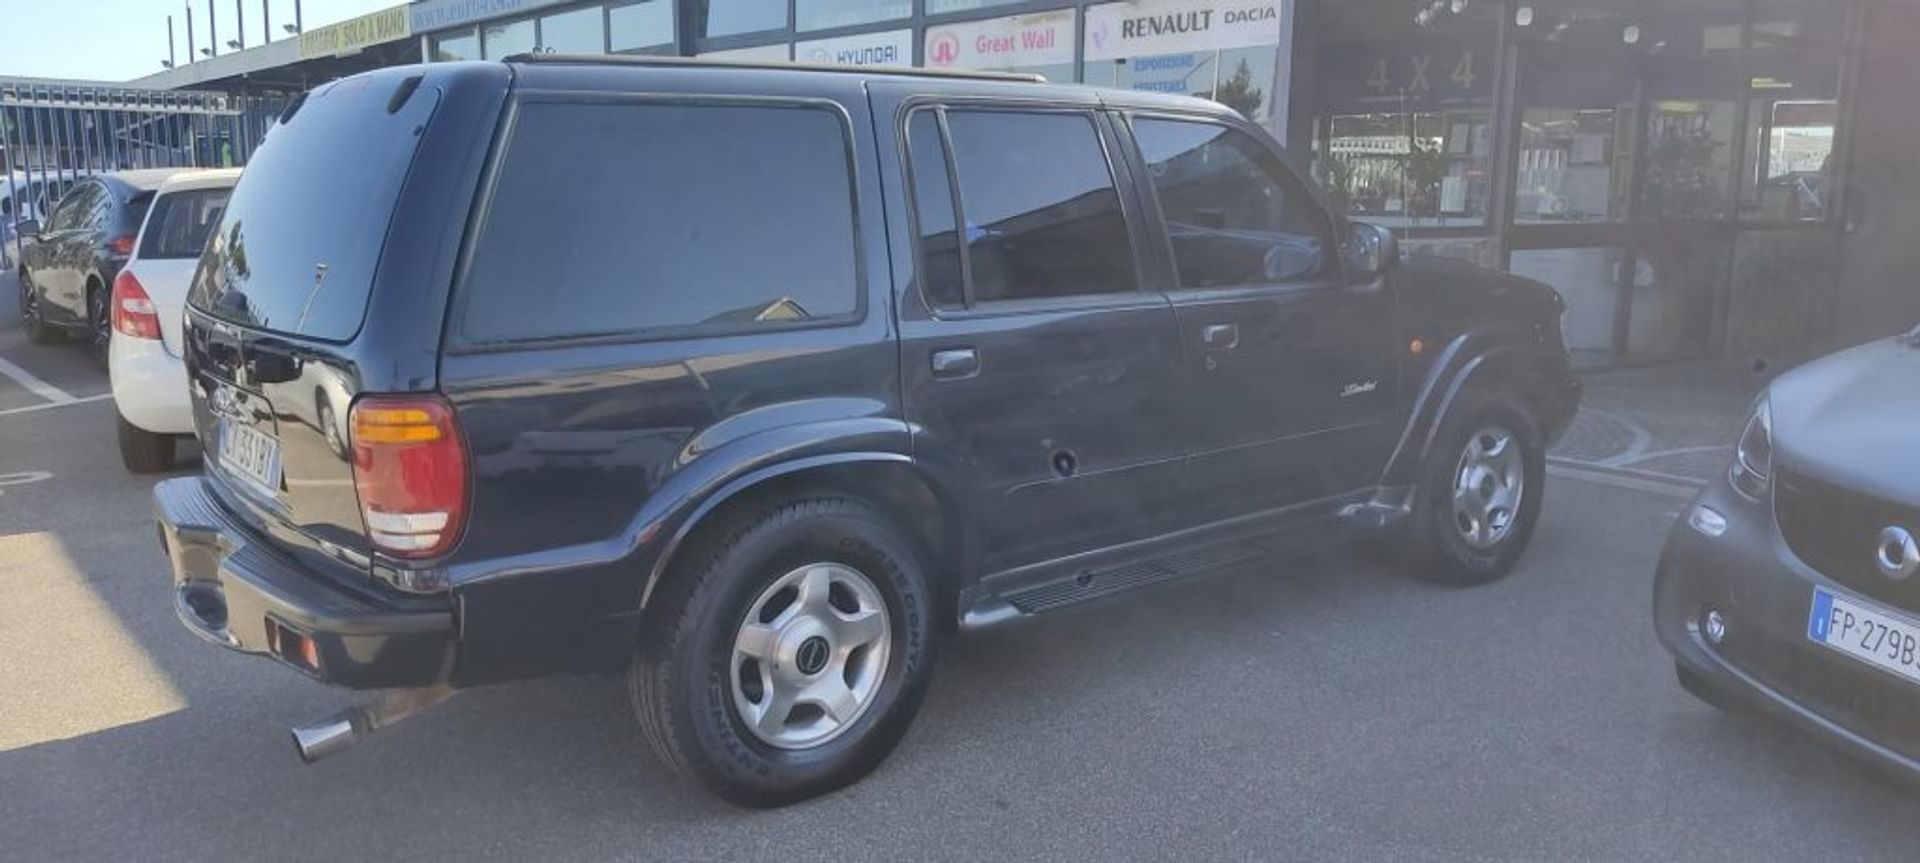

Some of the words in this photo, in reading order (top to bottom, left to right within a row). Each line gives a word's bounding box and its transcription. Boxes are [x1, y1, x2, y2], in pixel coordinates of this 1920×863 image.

[1122, 10, 1214, 39] RENAULT
[1224, 7, 1277, 24] DACIA
[837, 45, 898, 65] HYUNDAI
[975, 35, 1015, 54] Great
[1021, 28, 1055, 49] Wall
[1365, 59, 1389, 93] 4
[1450, 52, 1476, 89] 4
